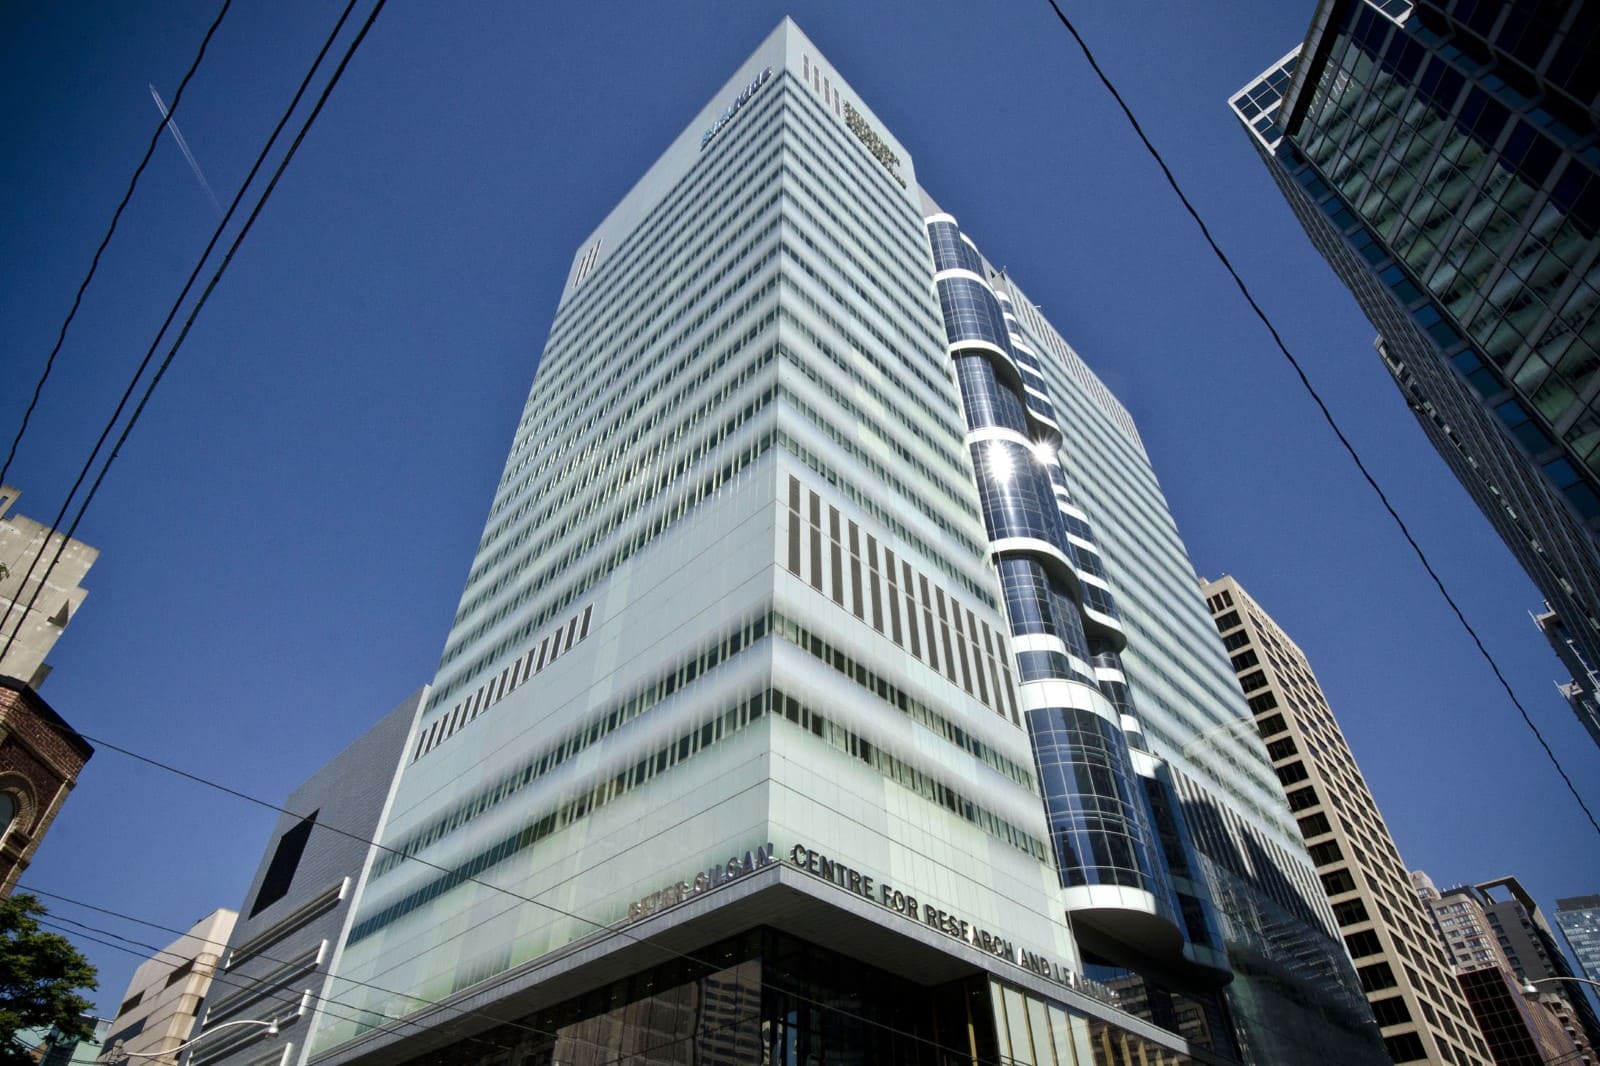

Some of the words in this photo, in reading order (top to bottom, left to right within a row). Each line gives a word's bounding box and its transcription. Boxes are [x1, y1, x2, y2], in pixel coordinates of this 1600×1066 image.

[694, 842, 775, 893] GILGAN
[790, 843, 875, 900] CENTRE
[880, 884, 919, 920] FOR
[923, 904, 1014, 962] RESEARCH
[1018, 947, 1050, 977] AND
